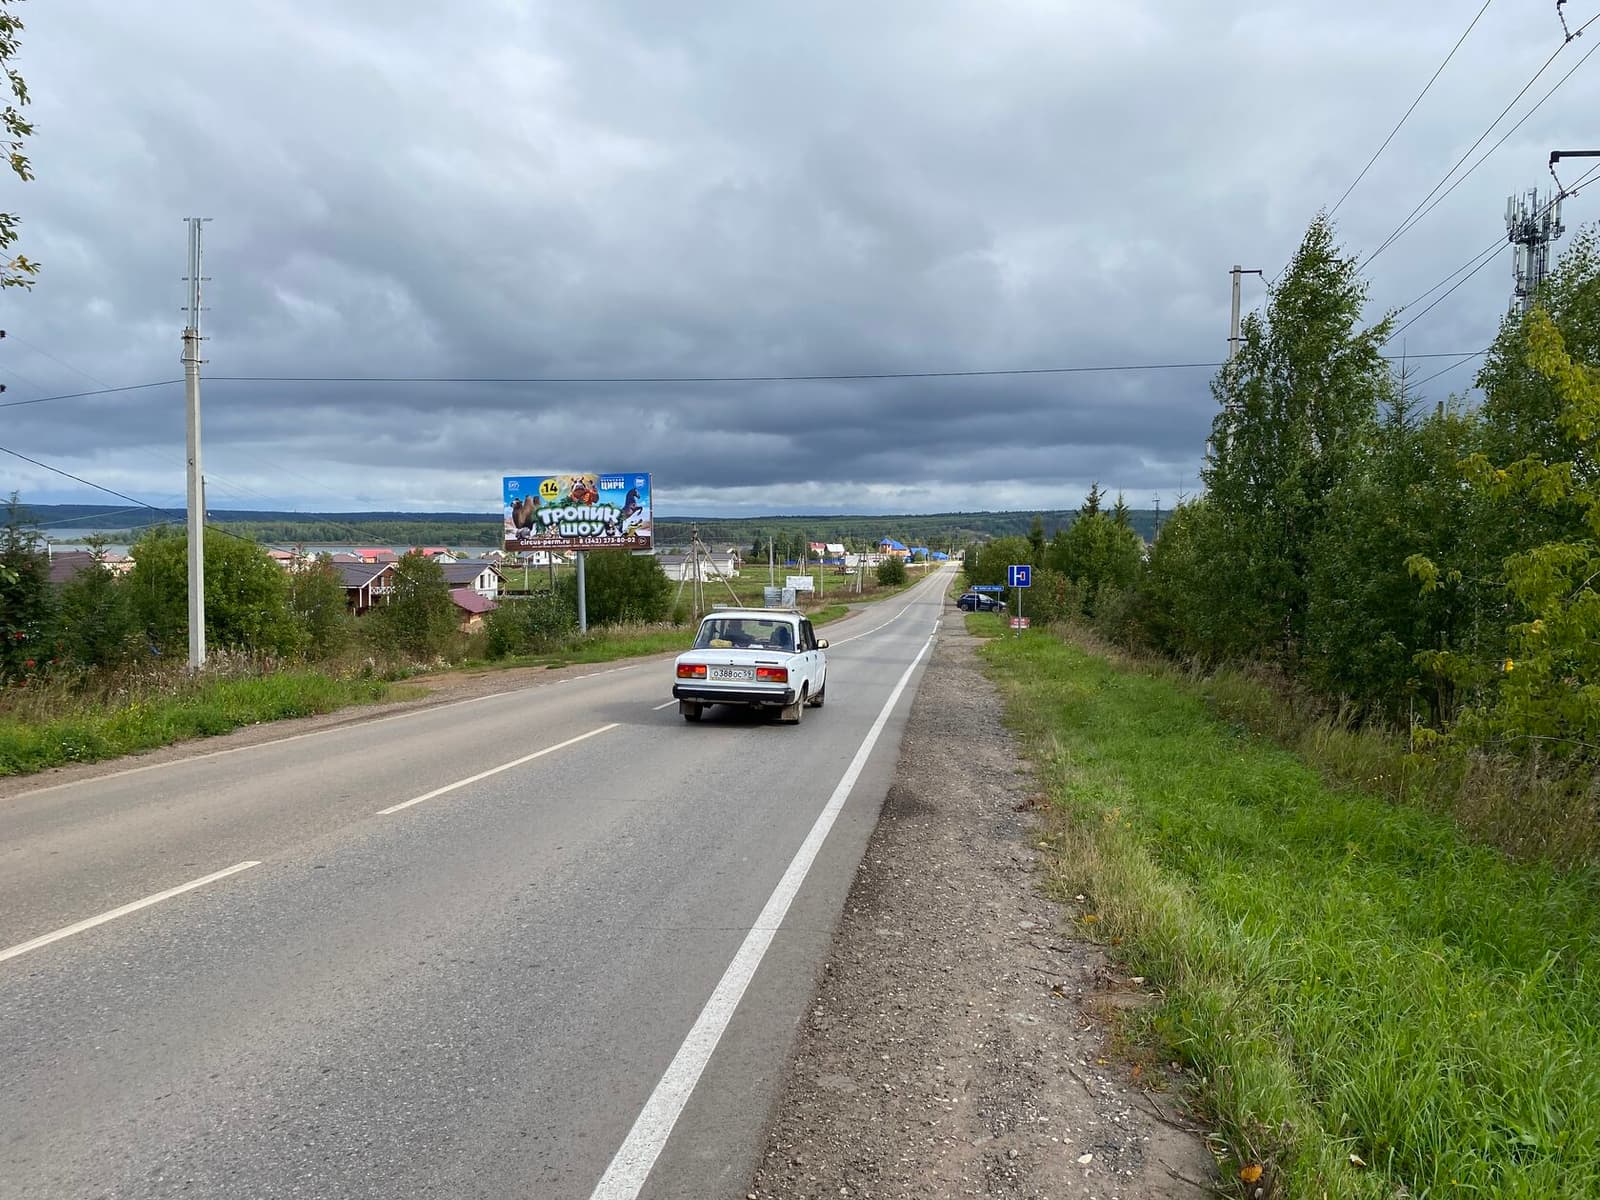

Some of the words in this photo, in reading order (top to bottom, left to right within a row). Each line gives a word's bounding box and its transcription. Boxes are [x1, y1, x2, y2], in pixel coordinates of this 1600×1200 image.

[544, 482, 558, 492] 14
[601, 482, 624, 490] ЦИРК
[537, 505, 621, 525] ТРОПИК
[560, 521, 604, 536] ШОУ
